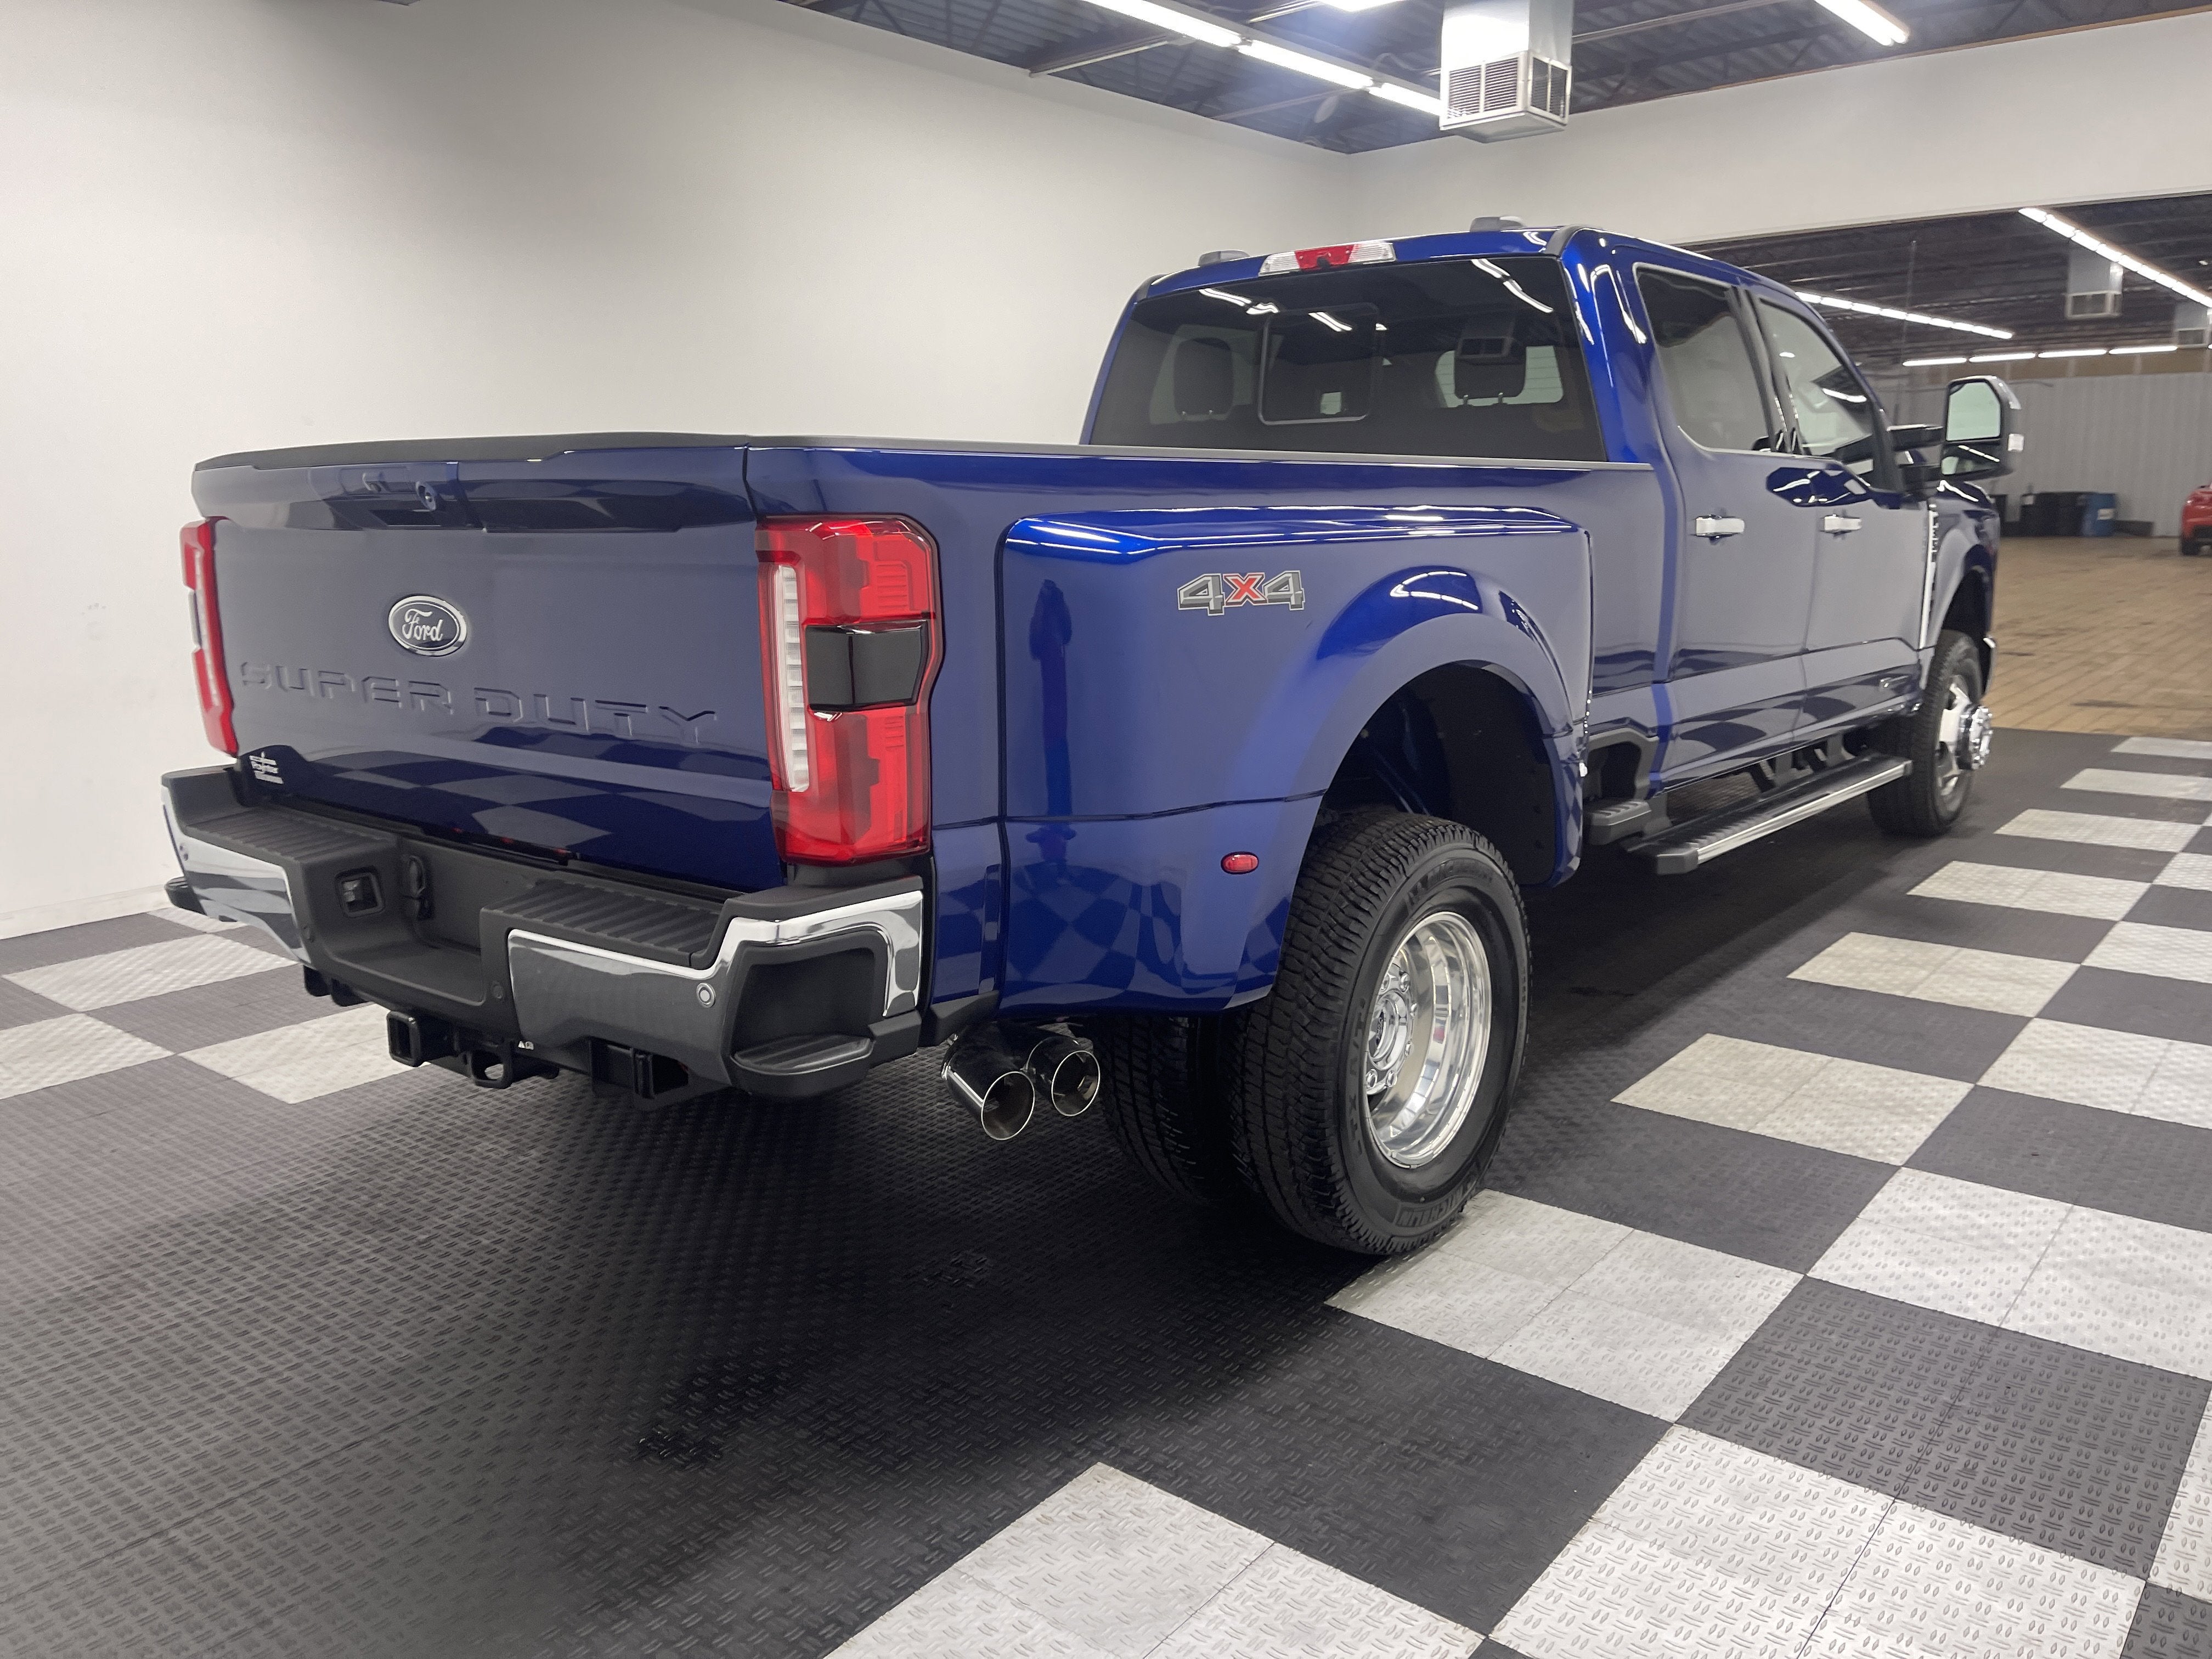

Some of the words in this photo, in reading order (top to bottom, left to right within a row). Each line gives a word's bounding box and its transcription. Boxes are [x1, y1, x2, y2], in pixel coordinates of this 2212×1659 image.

[402, 608, 444, 641] Ford
[240, 661, 454, 715] SUPER
[473, 686, 717, 744] DUTY
